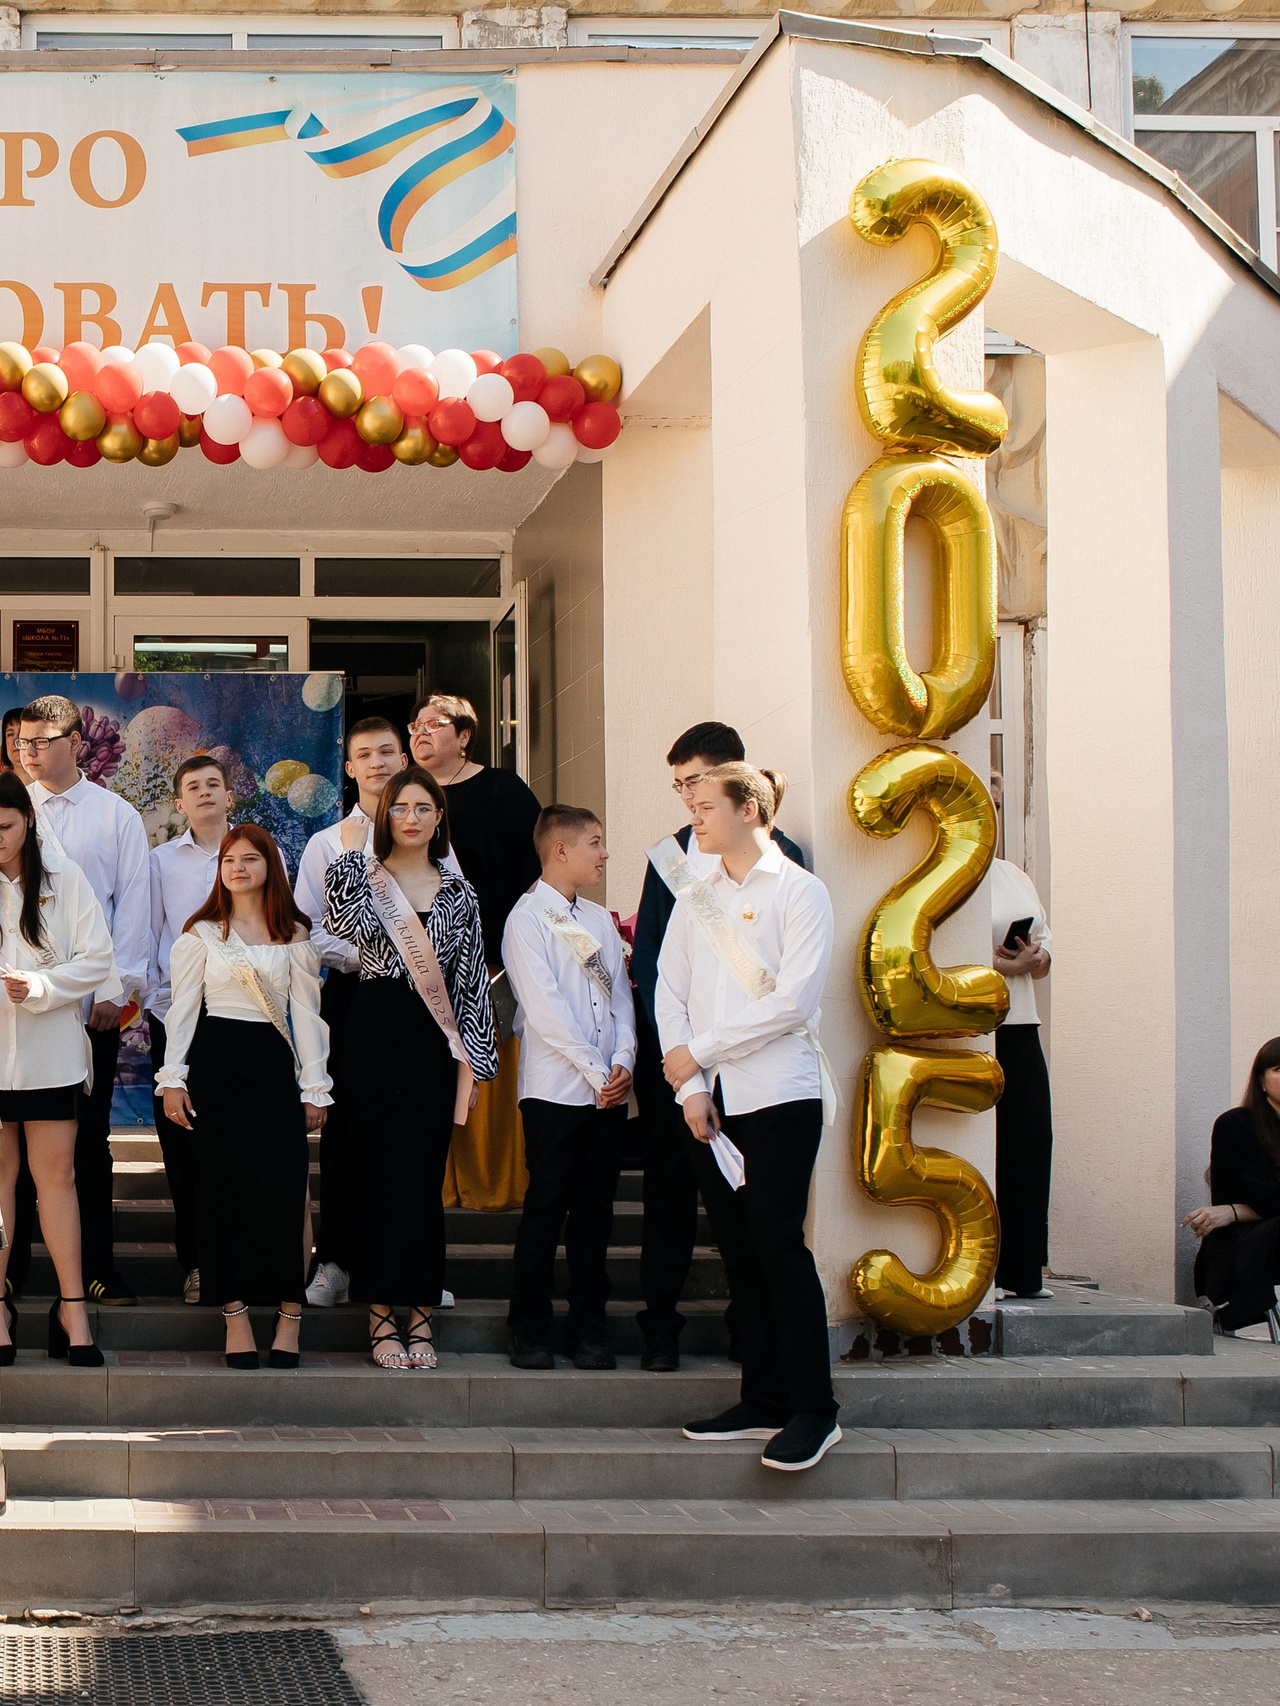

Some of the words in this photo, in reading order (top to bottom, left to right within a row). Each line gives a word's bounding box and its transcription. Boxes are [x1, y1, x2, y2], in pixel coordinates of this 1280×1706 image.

[371, 878, 430, 975] Выпускница
[426, 985, 451, 1026] 2025
[840, 158, 1011, 1335] 2025
